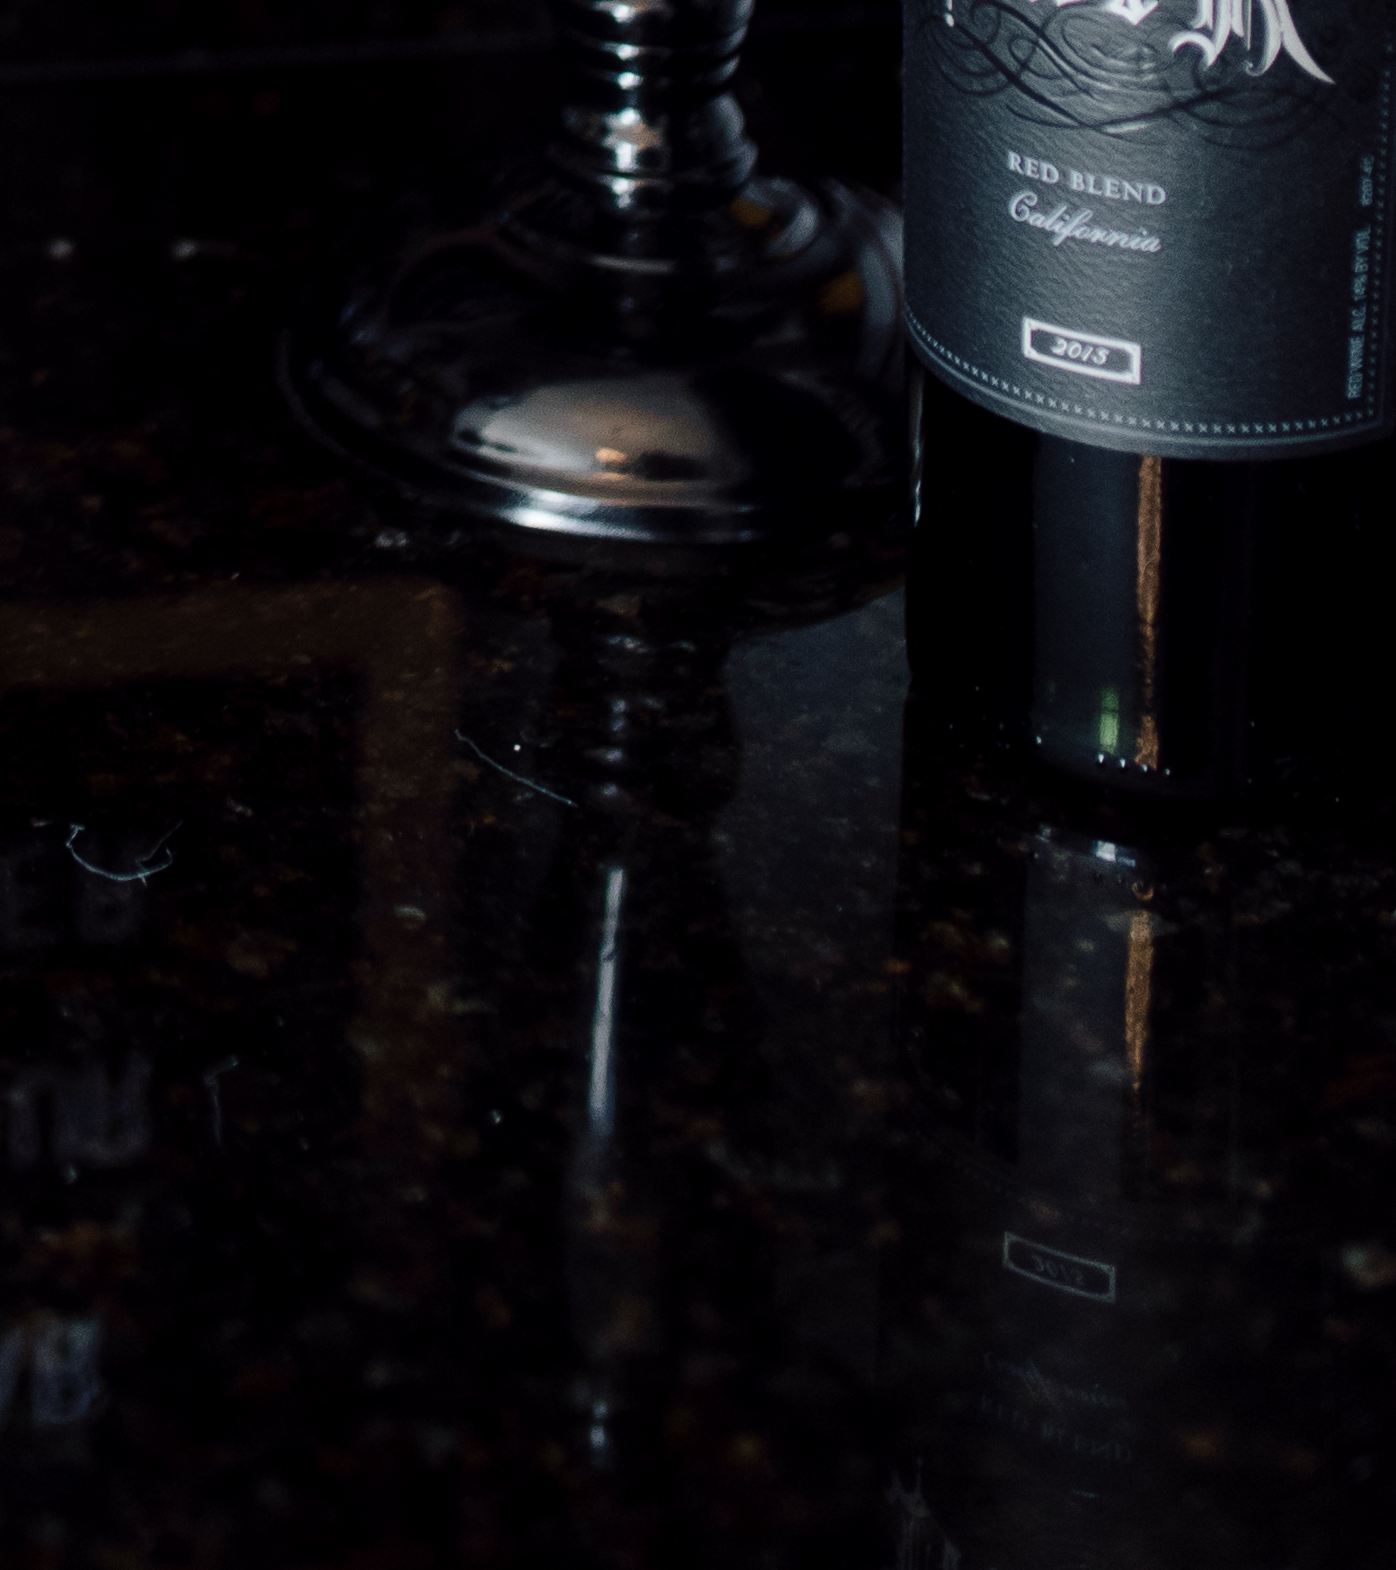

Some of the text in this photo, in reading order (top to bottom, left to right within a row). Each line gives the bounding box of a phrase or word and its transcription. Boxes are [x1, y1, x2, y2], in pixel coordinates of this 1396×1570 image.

[1008, 150, 1166, 206] RED BLEND
[1008, 189, 1162, 253] California
[1049, 336, 1110, 366] 2015
